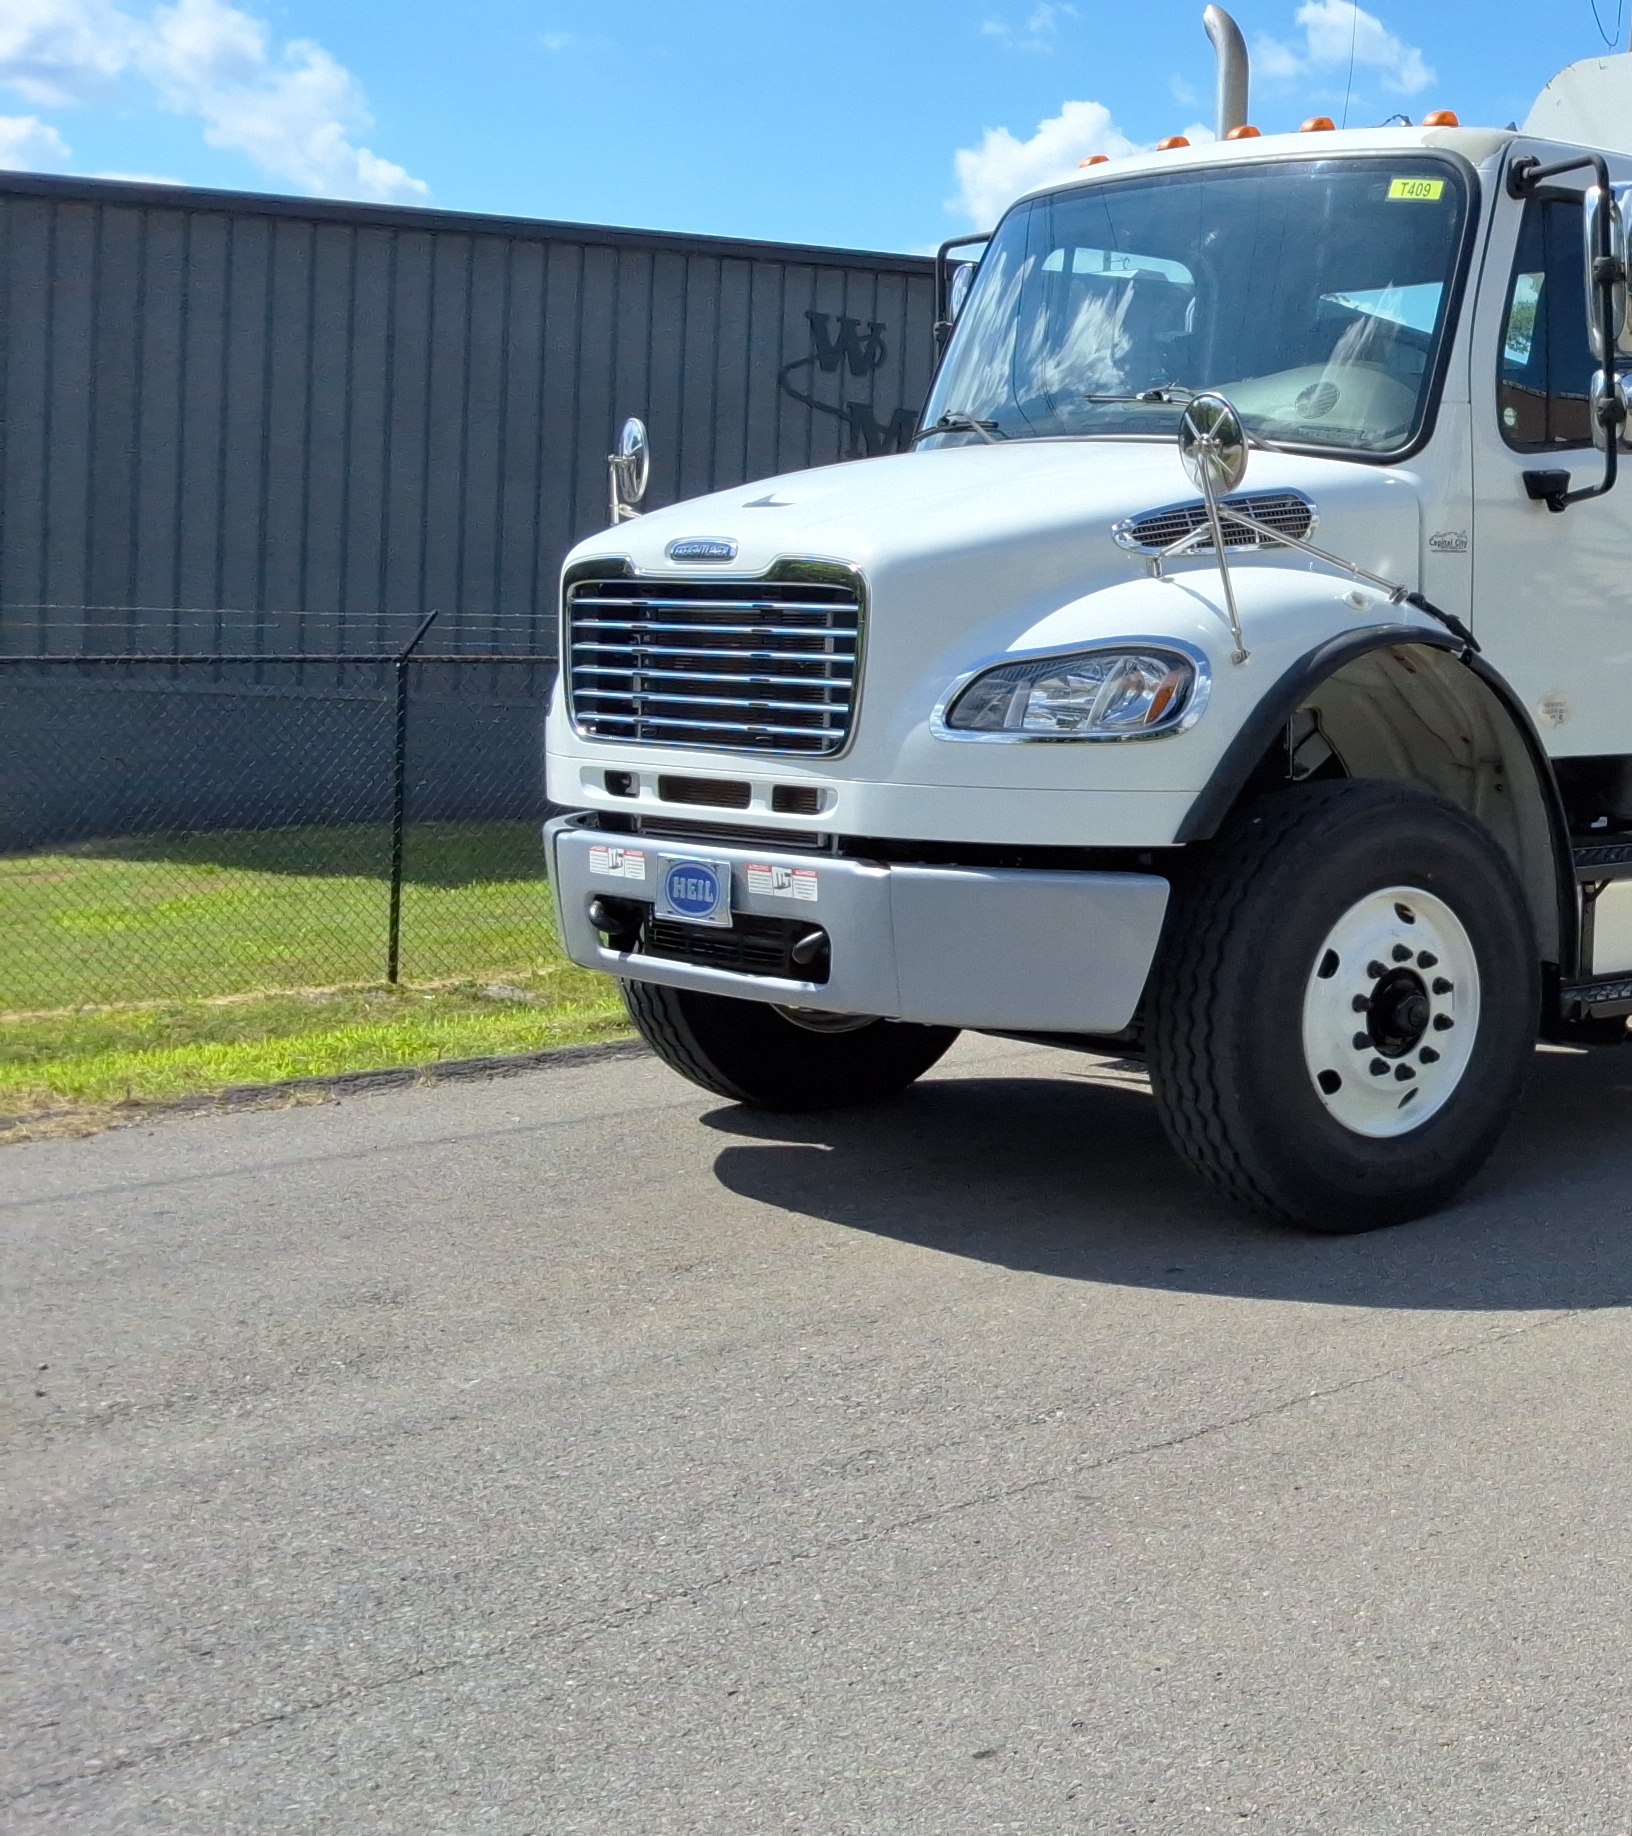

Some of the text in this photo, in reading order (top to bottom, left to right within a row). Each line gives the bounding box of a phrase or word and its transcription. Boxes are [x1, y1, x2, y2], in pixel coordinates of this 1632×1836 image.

[1400, 182, 1432, 197] T409
[1429, 536, 1468, 549] Capital City
[673, 876, 714, 903] HEIL
